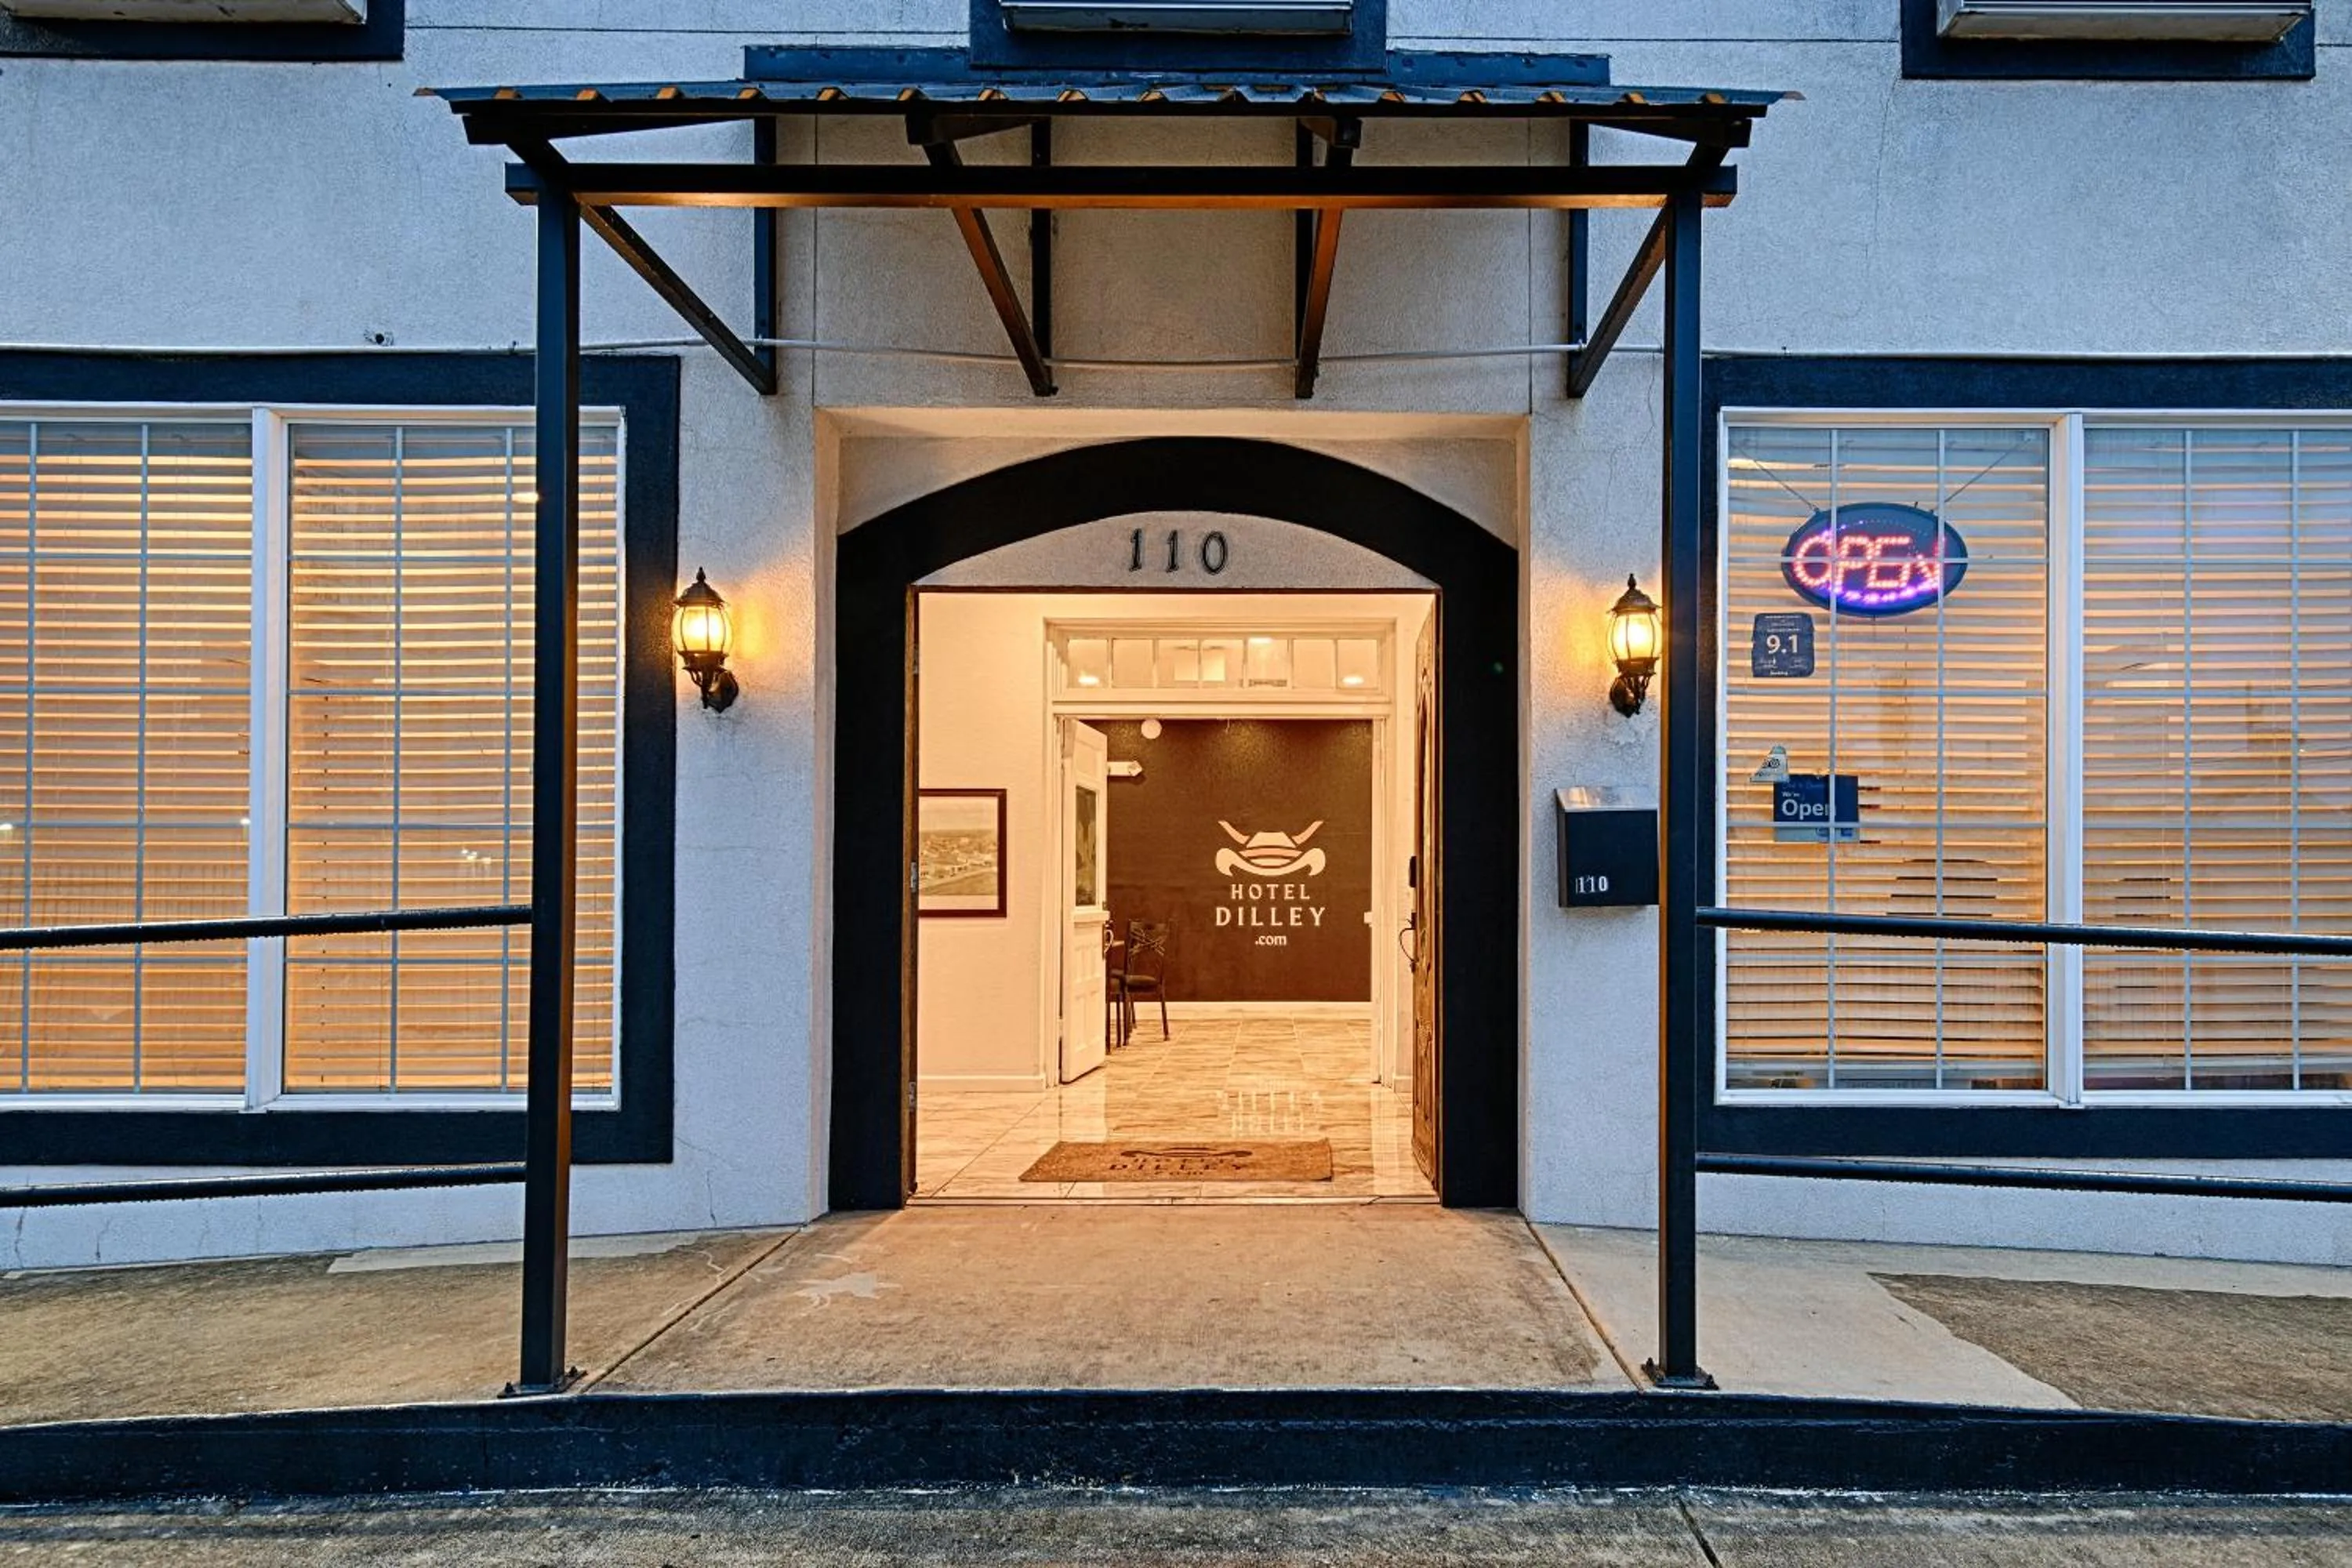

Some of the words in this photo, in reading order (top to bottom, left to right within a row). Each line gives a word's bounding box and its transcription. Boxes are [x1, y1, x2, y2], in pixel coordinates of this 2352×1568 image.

[1128, 528, 1228, 575] 110
[1792, 534, 1945, 593] OPEN
[1766, 634, 1798, 655] 9.1
[1231, 884, 1310, 899] HOTEL
[1579, 876, 1608, 893] 110
[1216, 907, 1325, 926] DILLEY
[1255, 935, 1287, 946] .com
